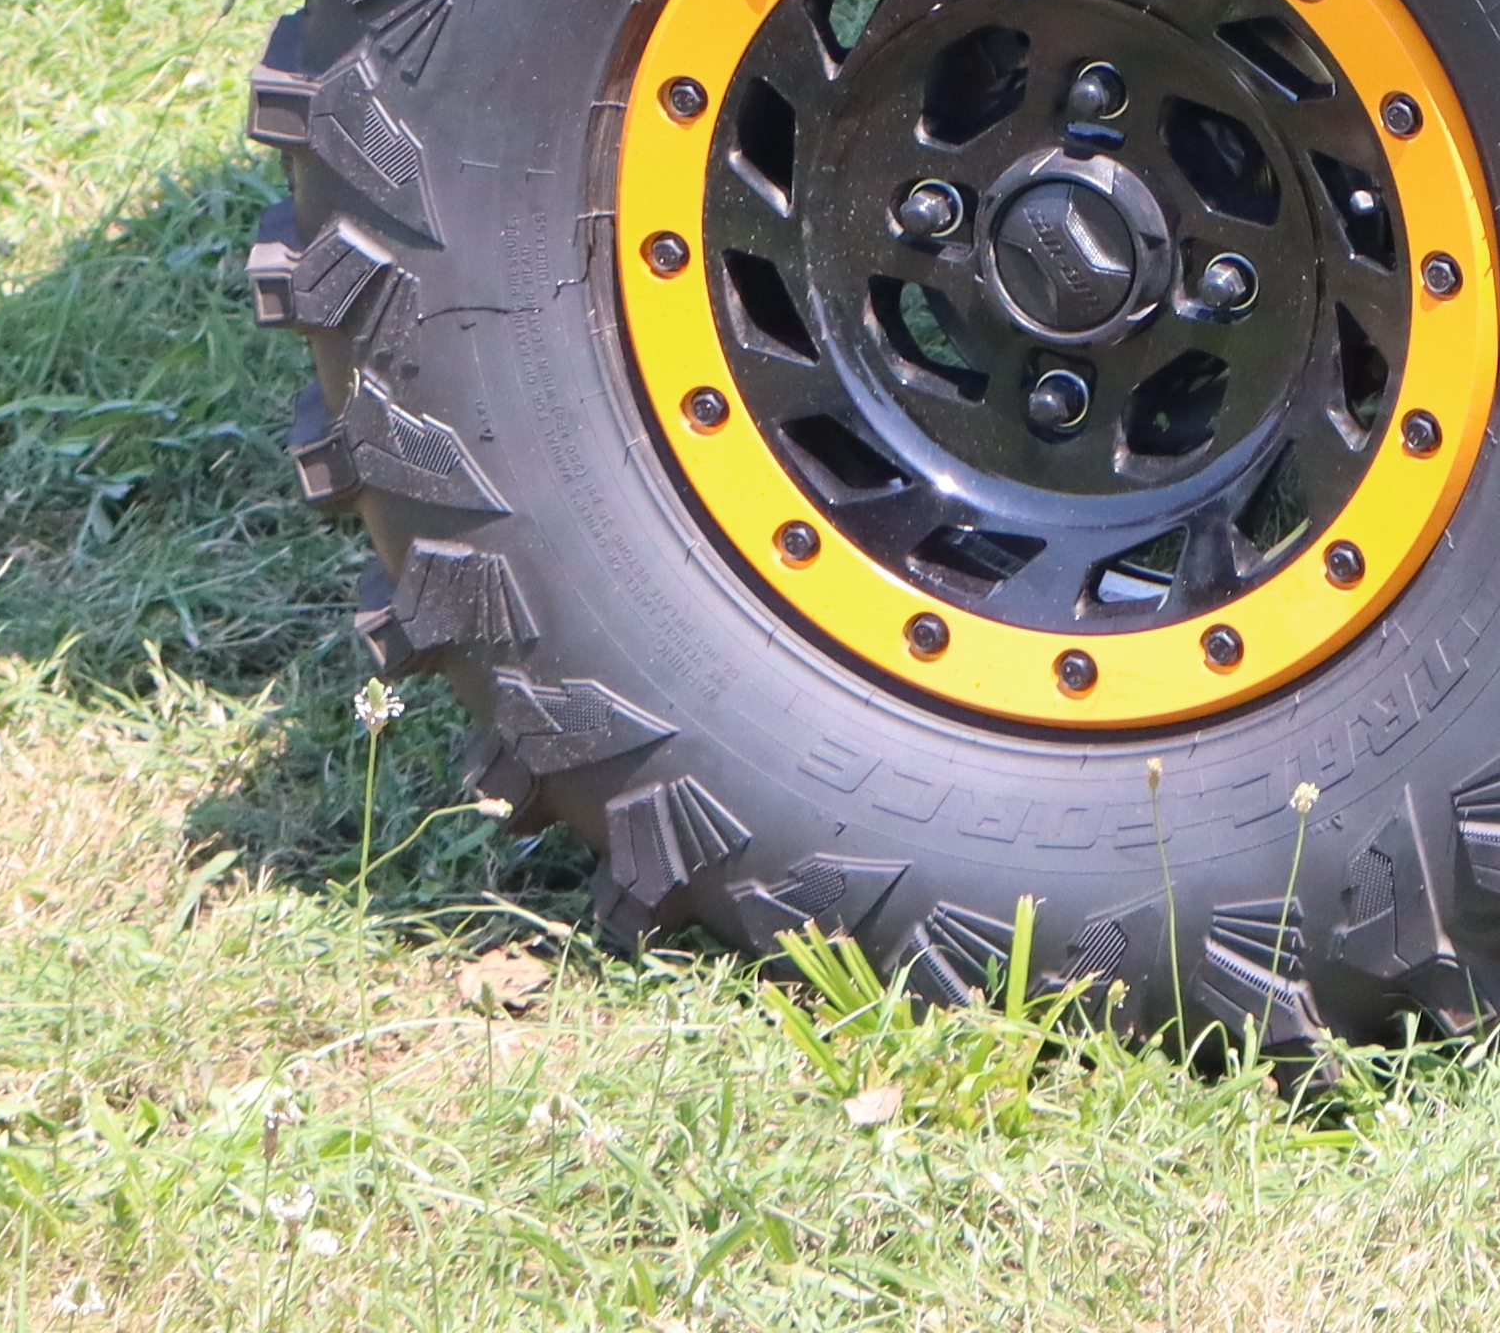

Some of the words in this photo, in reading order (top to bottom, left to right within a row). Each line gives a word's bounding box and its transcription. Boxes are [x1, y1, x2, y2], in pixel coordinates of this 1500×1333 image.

[541, 426, 575, 485] MANUAL
[645, 582, 696, 638] INFLATE
[654, 614, 707, 669] VEHICLE
[1227, 638, 1472, 830] TRAC
[796, 729, 1177, 850] FORCE
